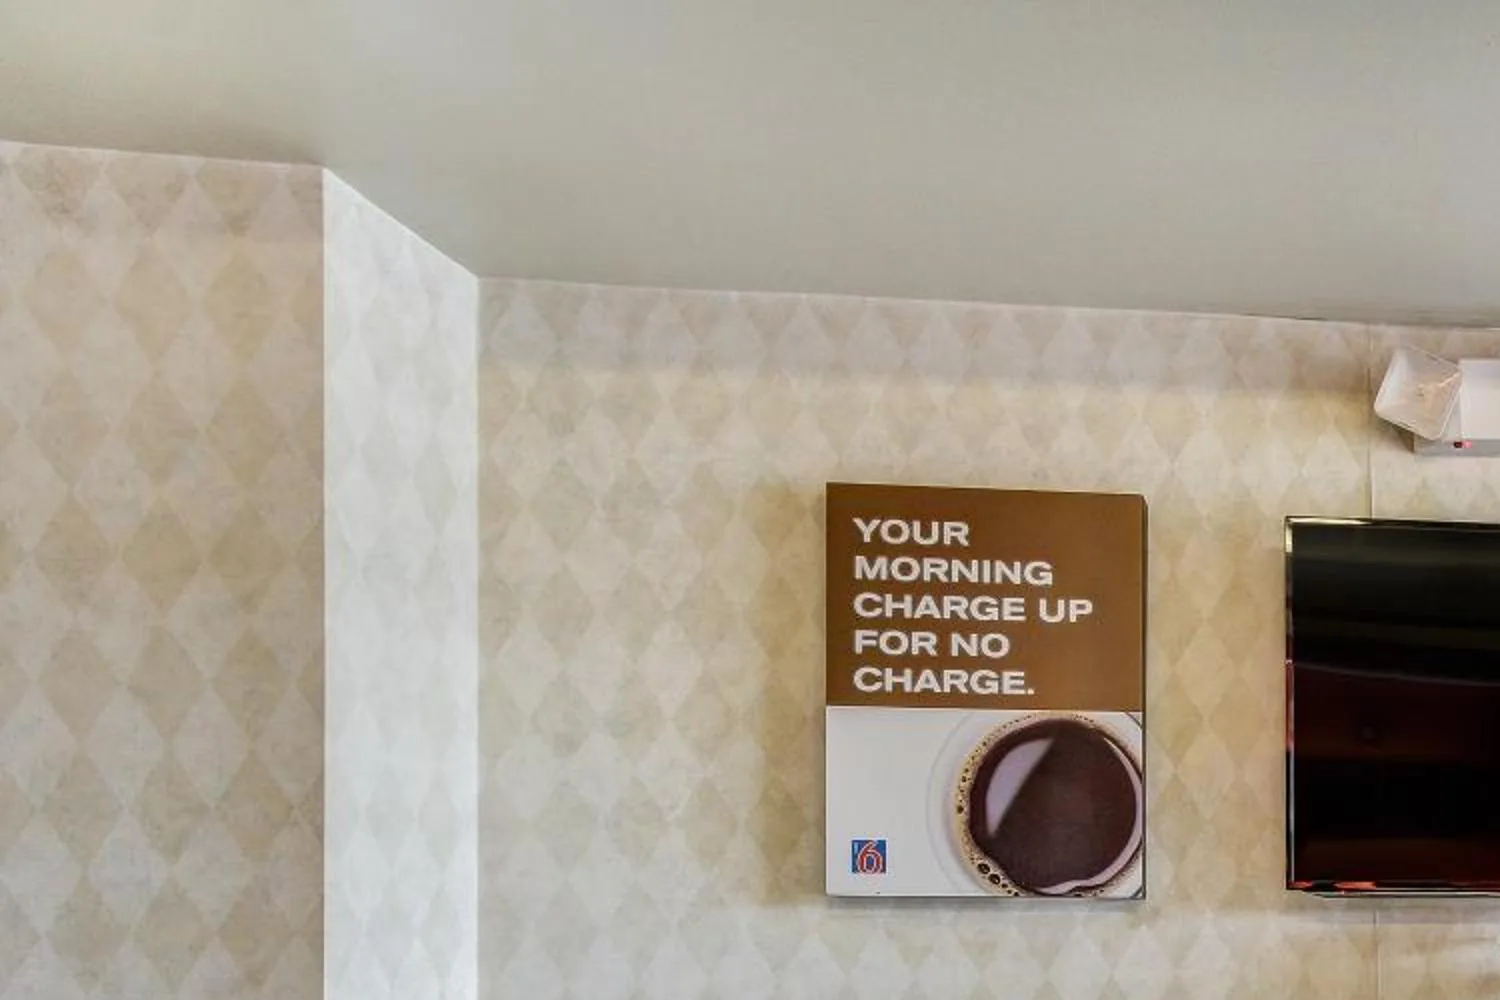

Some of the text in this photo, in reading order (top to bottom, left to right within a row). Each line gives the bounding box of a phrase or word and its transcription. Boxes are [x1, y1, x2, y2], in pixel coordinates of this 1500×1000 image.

[853, 517, 970, 546] YOUR
[853, 555, 1054, 586] MORNING
[853, 592, 1093, 623] CHARGE UP
[853, 629, 1010, 659] FOR NO
[853, 666, 1035, 695] CHARGE.
[856, 840, 884, 874] 6
